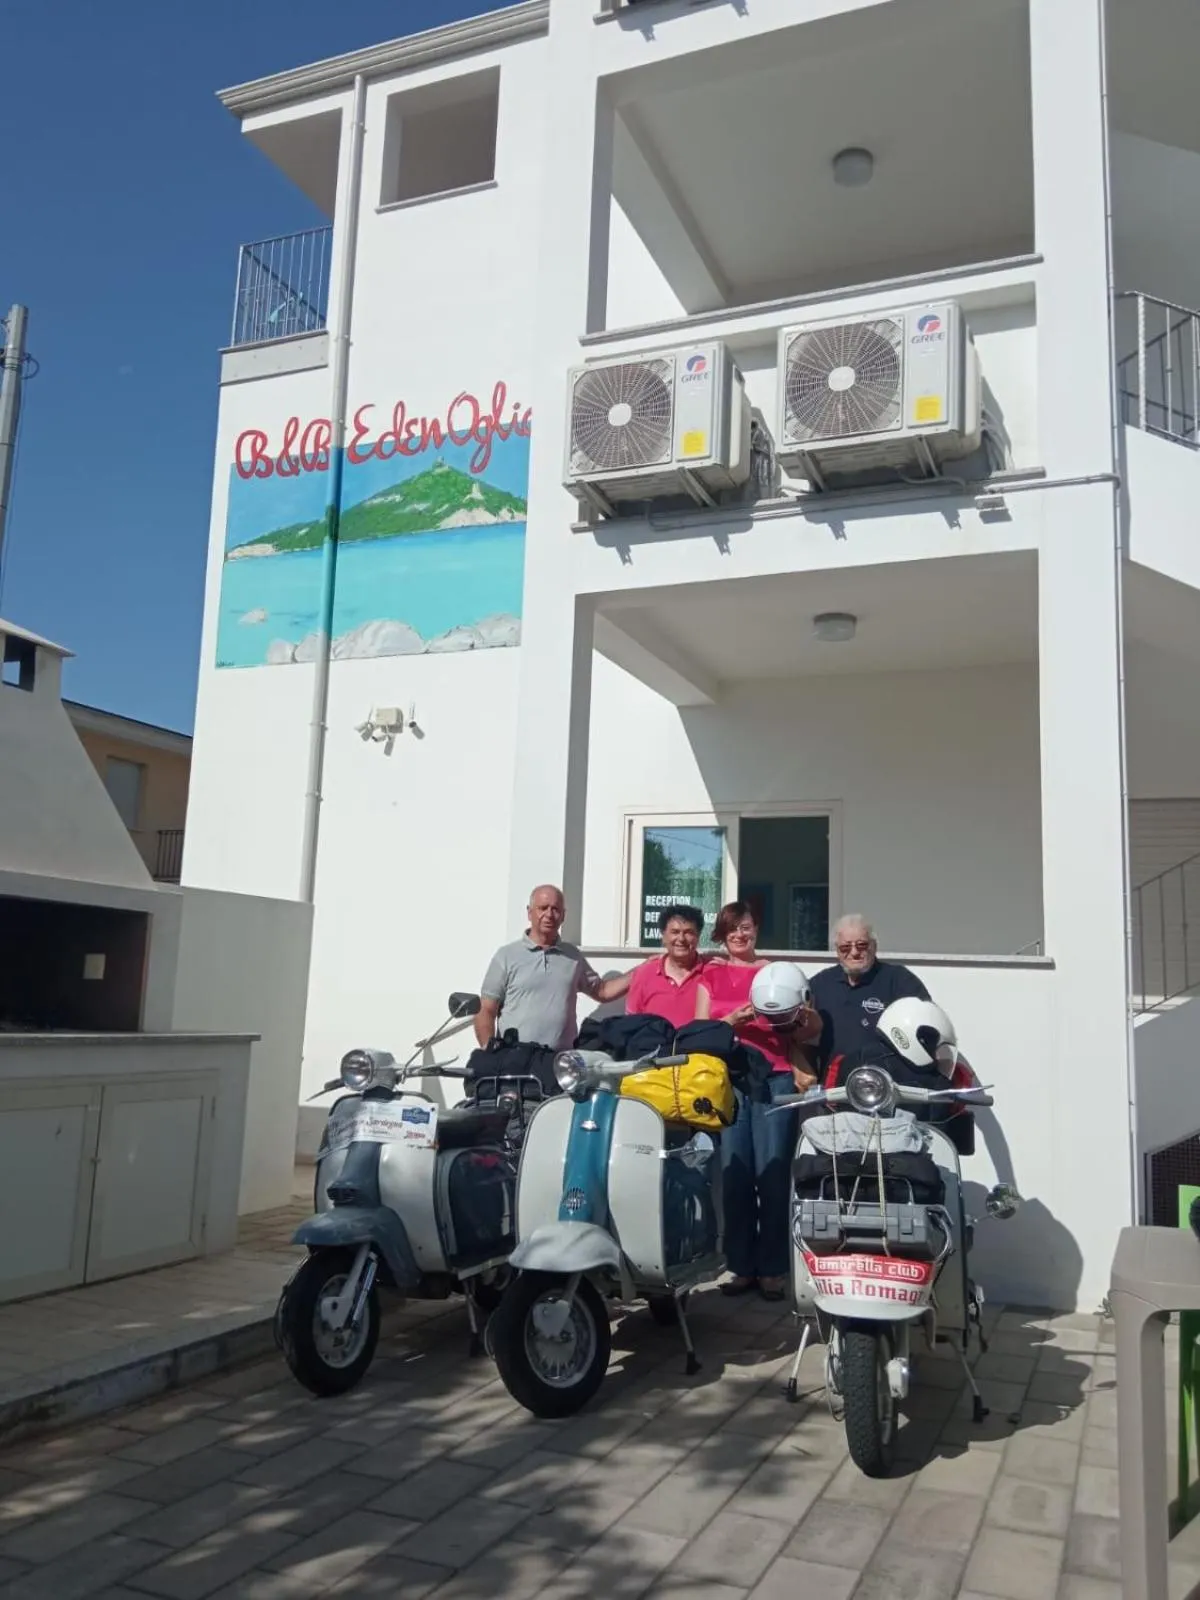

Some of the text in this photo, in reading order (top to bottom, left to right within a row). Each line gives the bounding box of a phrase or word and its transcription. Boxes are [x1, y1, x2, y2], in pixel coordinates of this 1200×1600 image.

[911, 332, 945, 344] GREE
[681, 372, 709, 384] GREE
[235, 416, 332, 480] B&B
[347, 400, 447, 465] Eden
[645, 895, 691, 906] RECEPTION
[888, 1264, 919, 1278] club
